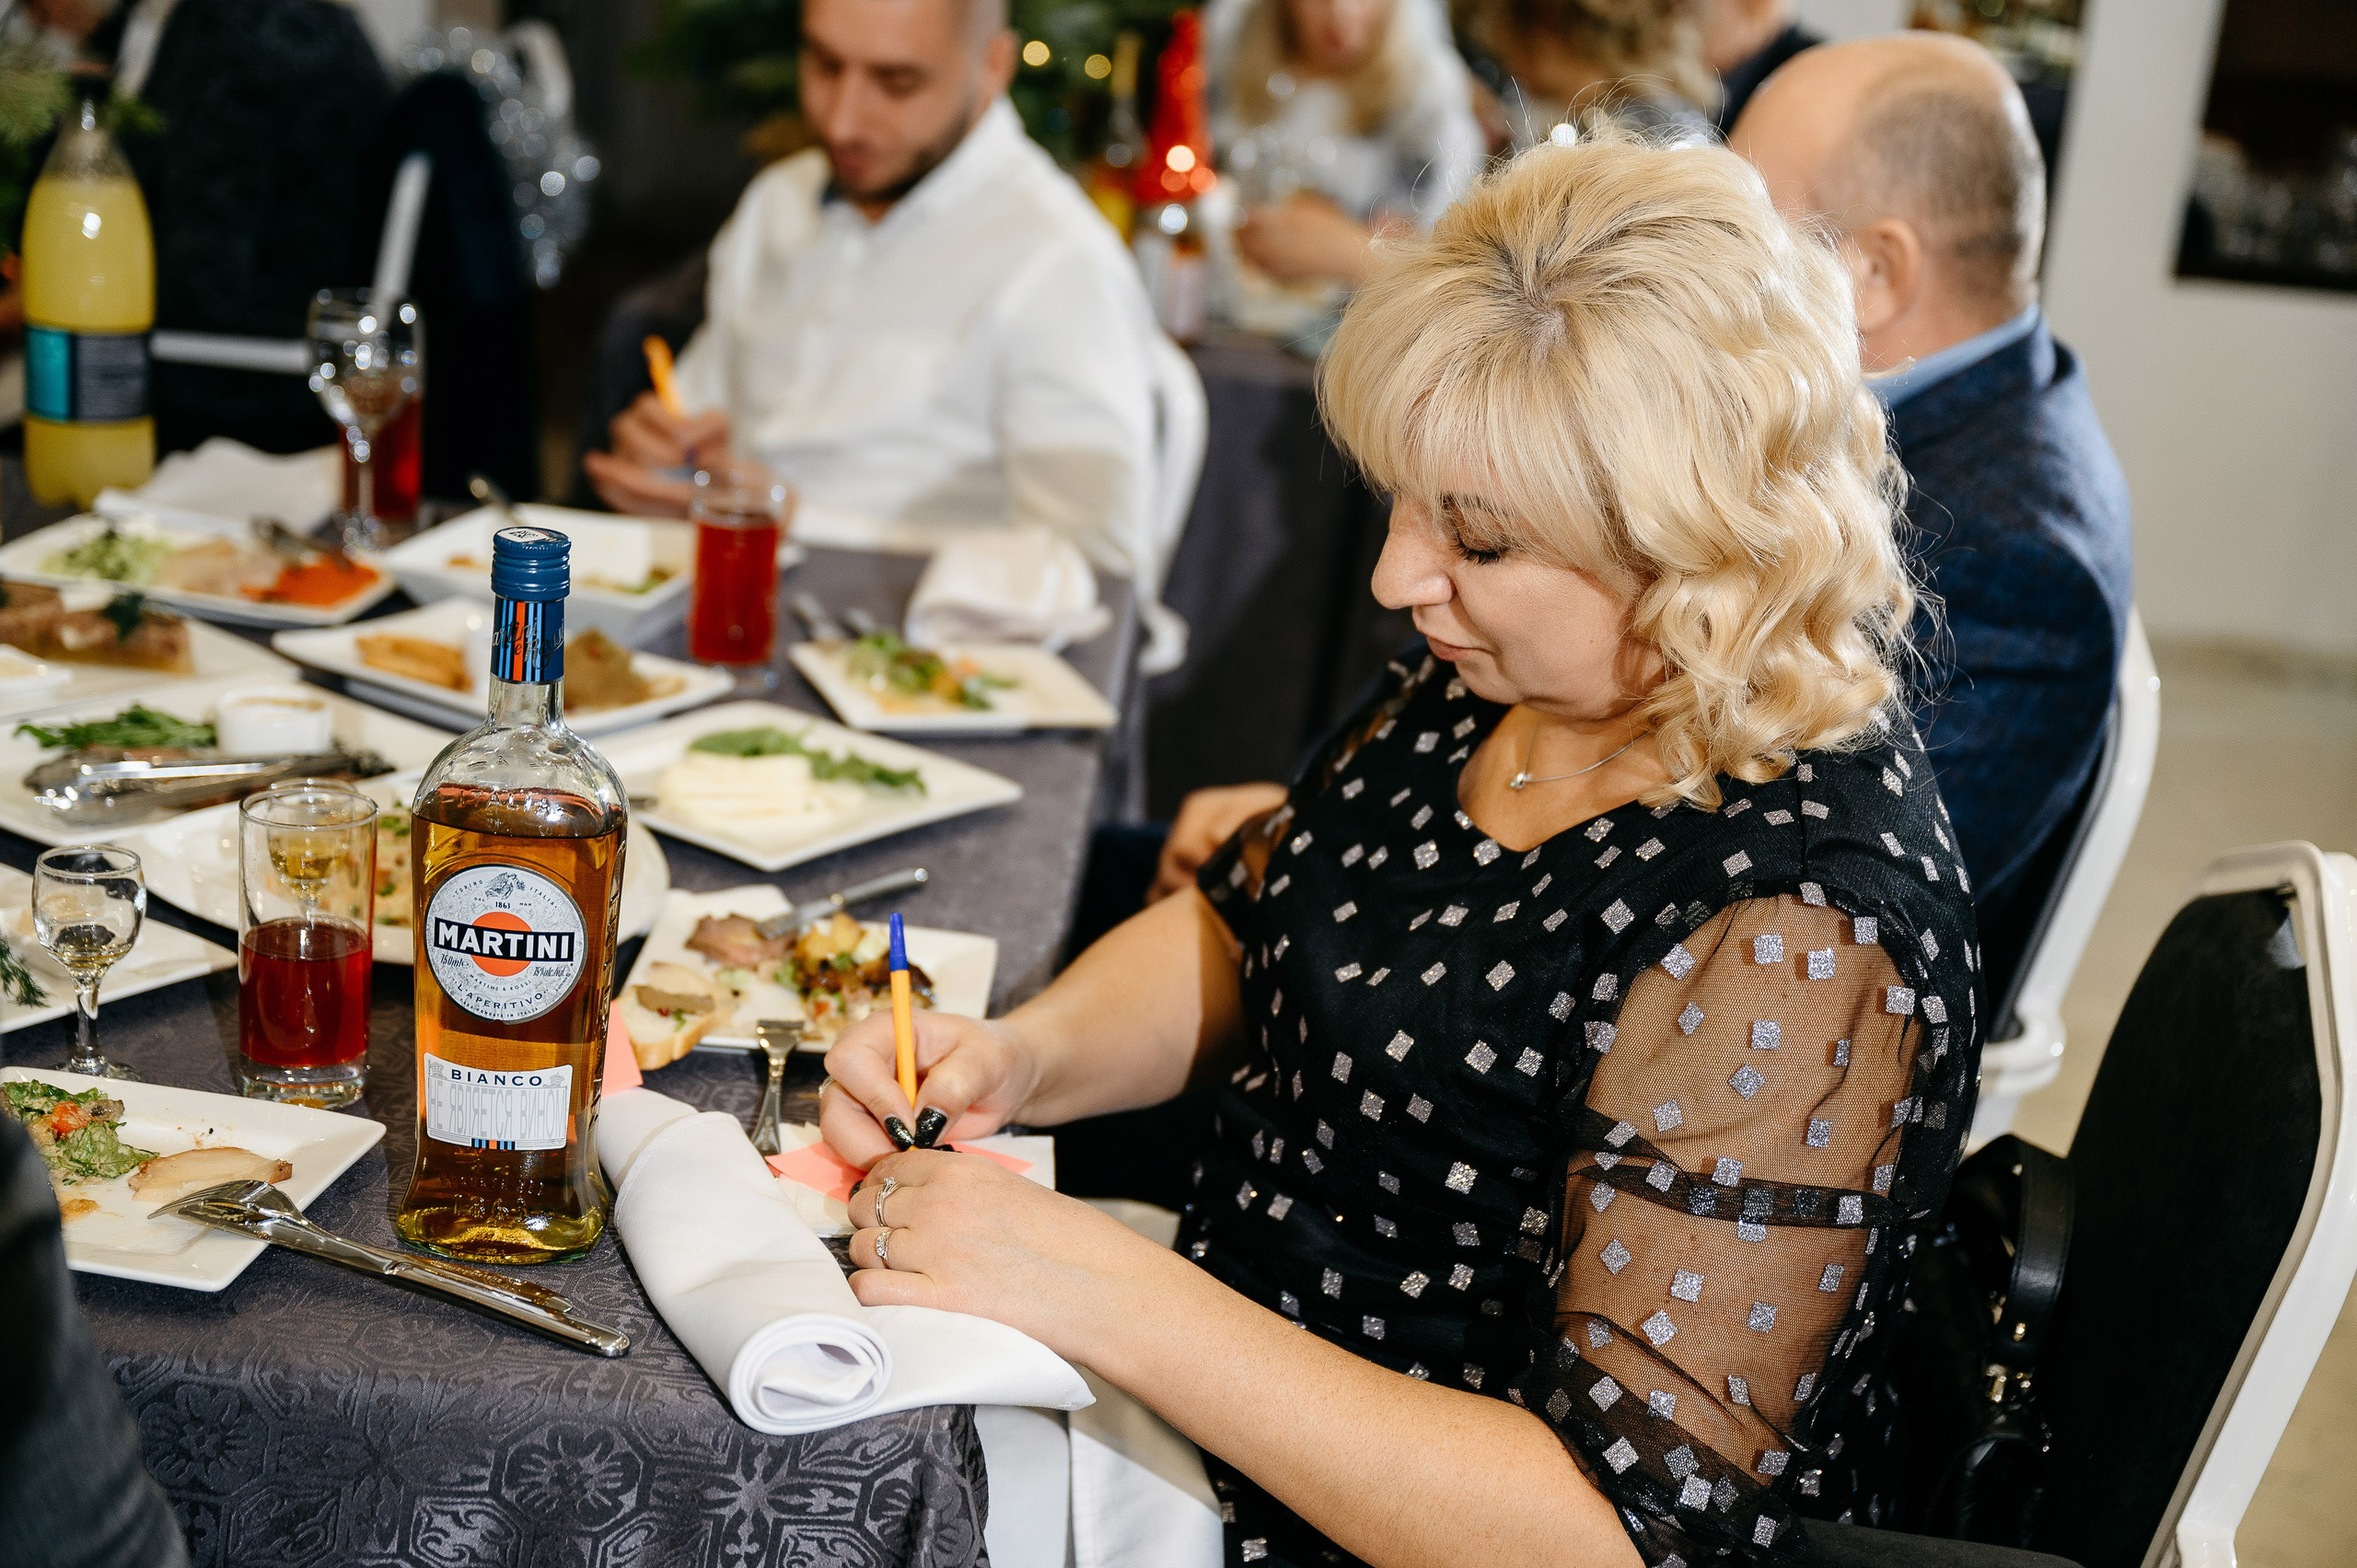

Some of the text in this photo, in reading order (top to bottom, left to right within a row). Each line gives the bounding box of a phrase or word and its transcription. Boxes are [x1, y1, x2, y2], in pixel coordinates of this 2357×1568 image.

[493, 617, 538, 649] artini
[455, 879, 555, 906] TORINO ITALIA
[495, 901, 511, 910] 1863
[438, 921, 569, 959] MARTINI
[451, 1069, 542, 1086] BIANCO
[449, 1083, 513, 1139] ЯВЛЯЕТСЯ
[519, 1089, 564, 1140] ВИНОМ
